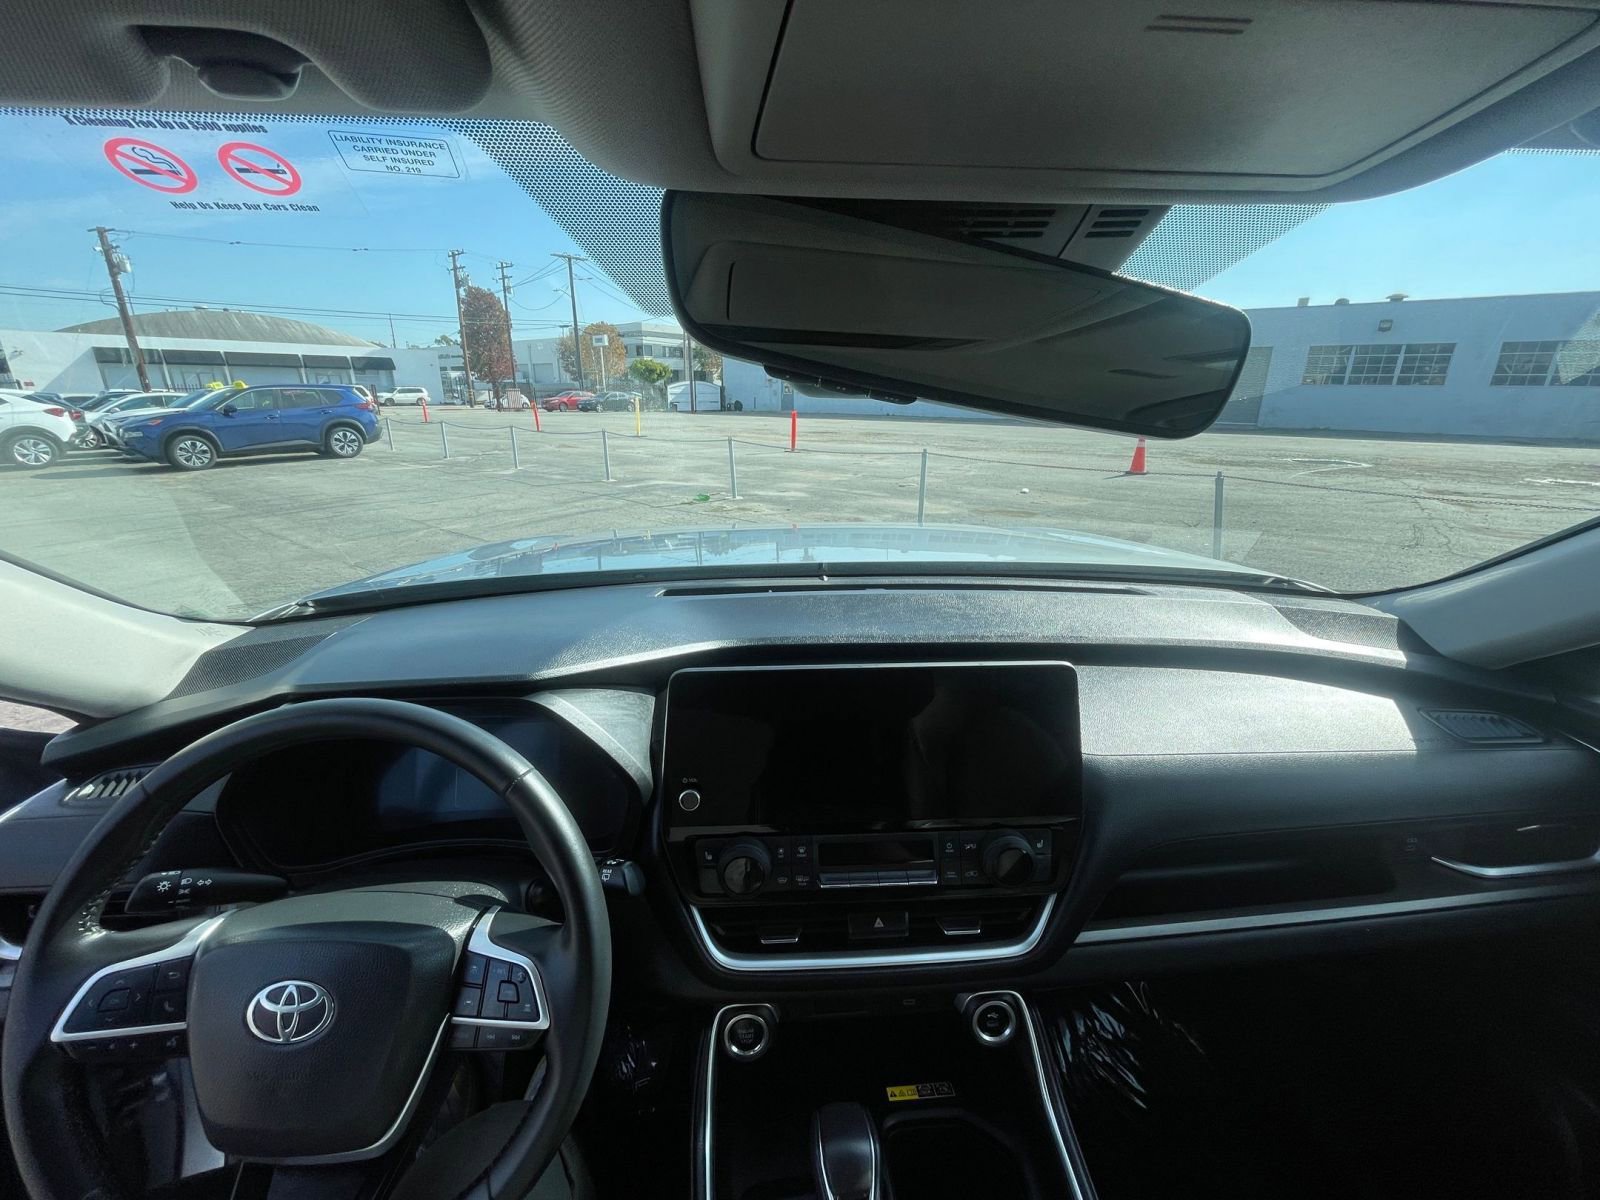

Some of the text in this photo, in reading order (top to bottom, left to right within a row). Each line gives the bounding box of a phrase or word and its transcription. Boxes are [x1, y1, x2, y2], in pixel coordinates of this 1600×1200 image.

[73, 114, 136, 128] Cleaning
[152, 117, 177, 130] Up
[172, 120, 190, 130] to
[187, 120, 223, 131] $500
[221, 123, 268, 133] applies
[333, 134, 446, 150] LIABILITY INSURANCE
[352, 145, 437, 158] CARRIED UNDER
[362, 154, 435, 166] SELF INSURED
[170, 201, 320, 212] Help Us Keep Our Cars Clean
